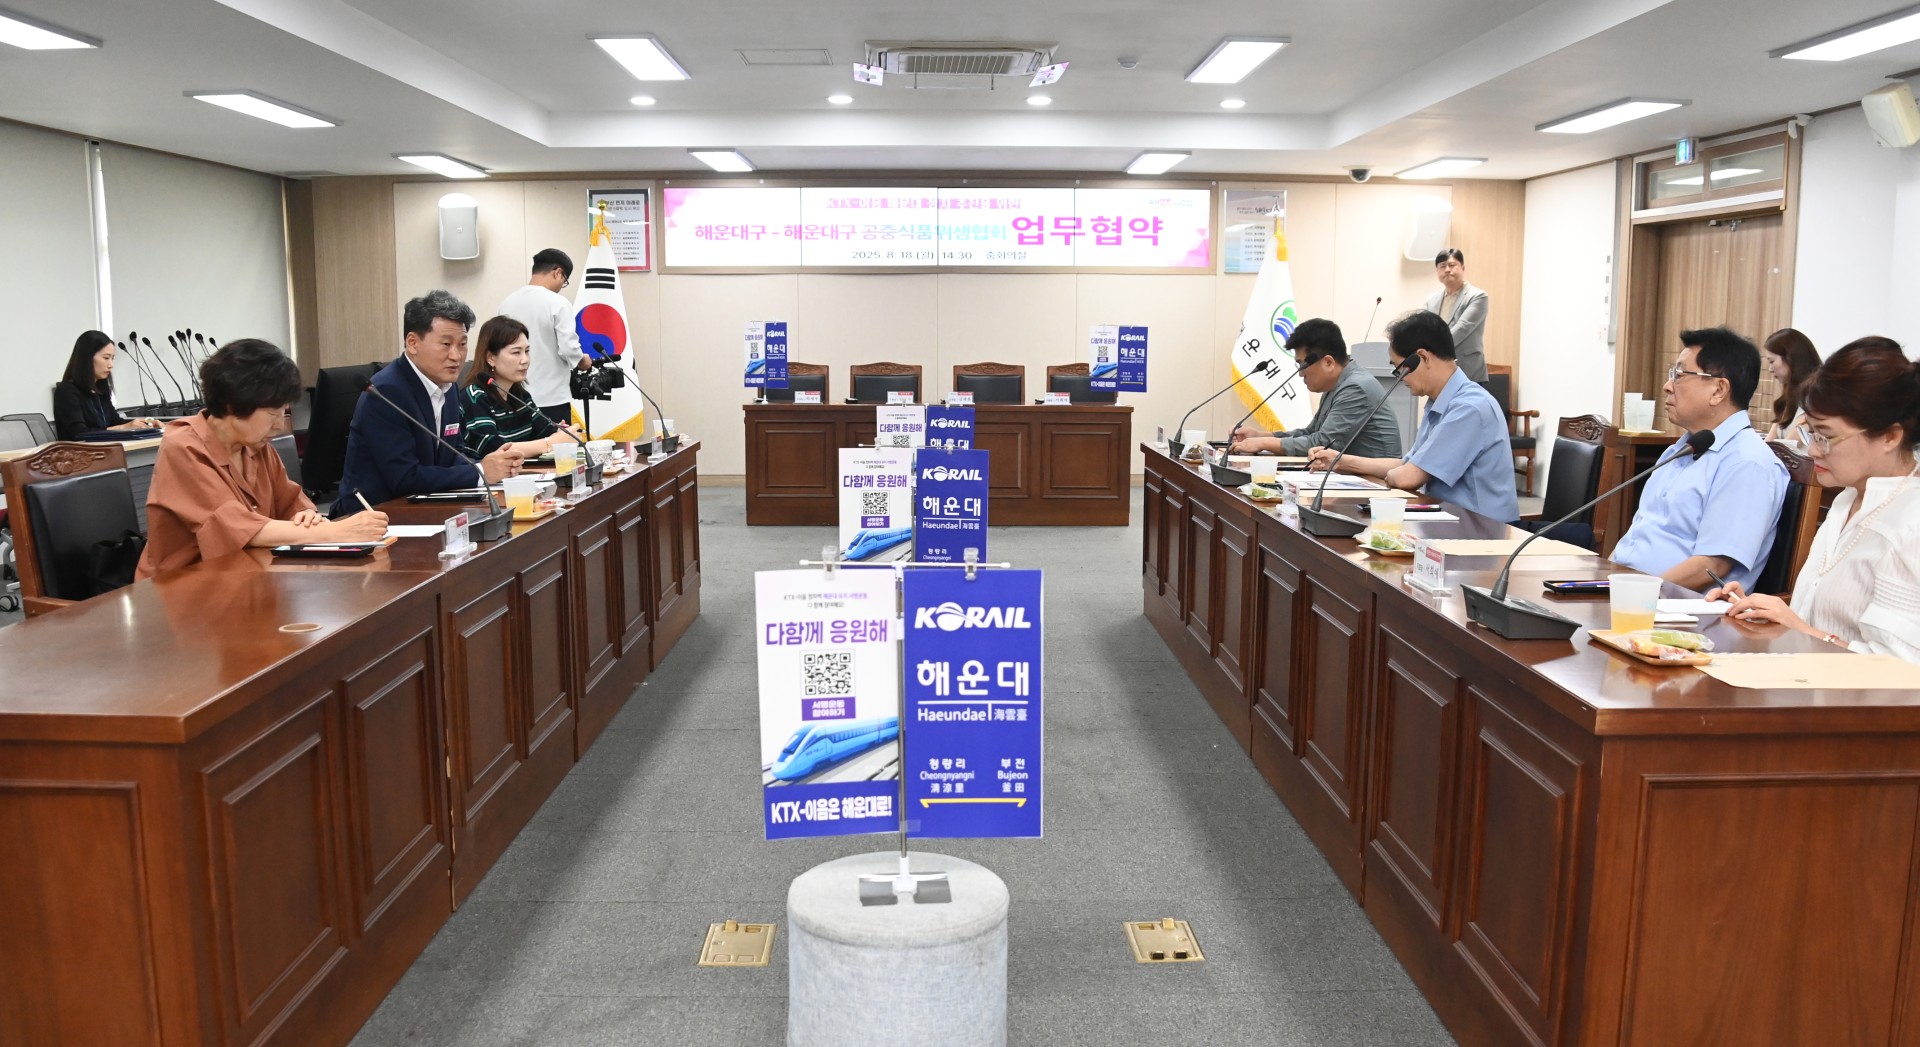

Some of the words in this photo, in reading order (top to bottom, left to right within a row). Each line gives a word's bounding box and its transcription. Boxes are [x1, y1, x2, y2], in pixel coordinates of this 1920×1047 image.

[694, 224, 767, 241] 해운대구
[784, 224, 857, 241] 해운대구
[861, 224, 1007, 241] 공중식품위생협회
[1012, 215, 1164, 246] 업무협약
[852, 251, 883, 260] 2025.
[887, 251, 897, 260] 8.
[942, 251, 973, 260] 14:30
[879, 423, 900, 433] 다함께
[902, 423, 923, 433] 응원해
[930, 417, 971, 429] KORAIL
[843, 475, 874, 488] 다함께
[876, 474, 908, 488] 응원해
[922, 466, 983, 482] KORAIL
[922, 496, 981, 517] 해운대
[922, 521, 958, 530] Haeundae
[914, 601, 1031, 632] KORAIL
[766, 621, 823, 646] 다함께
[830, 619, 888, 644] 응원해
[916, 659, 1029, 697] 해운대
[917, 707, 987, 722] Haeundae
[929, 758, 966, 770] 청량리
[1001, 758, 1026, 770] 부전
[919, 770, 975, 782] Cheongnyangni
[997, 770, 1029, 781] Bujeon
[771, 798, 840, 823] KTX-이음은
[841, 796, 893, 819] 해운대로!
